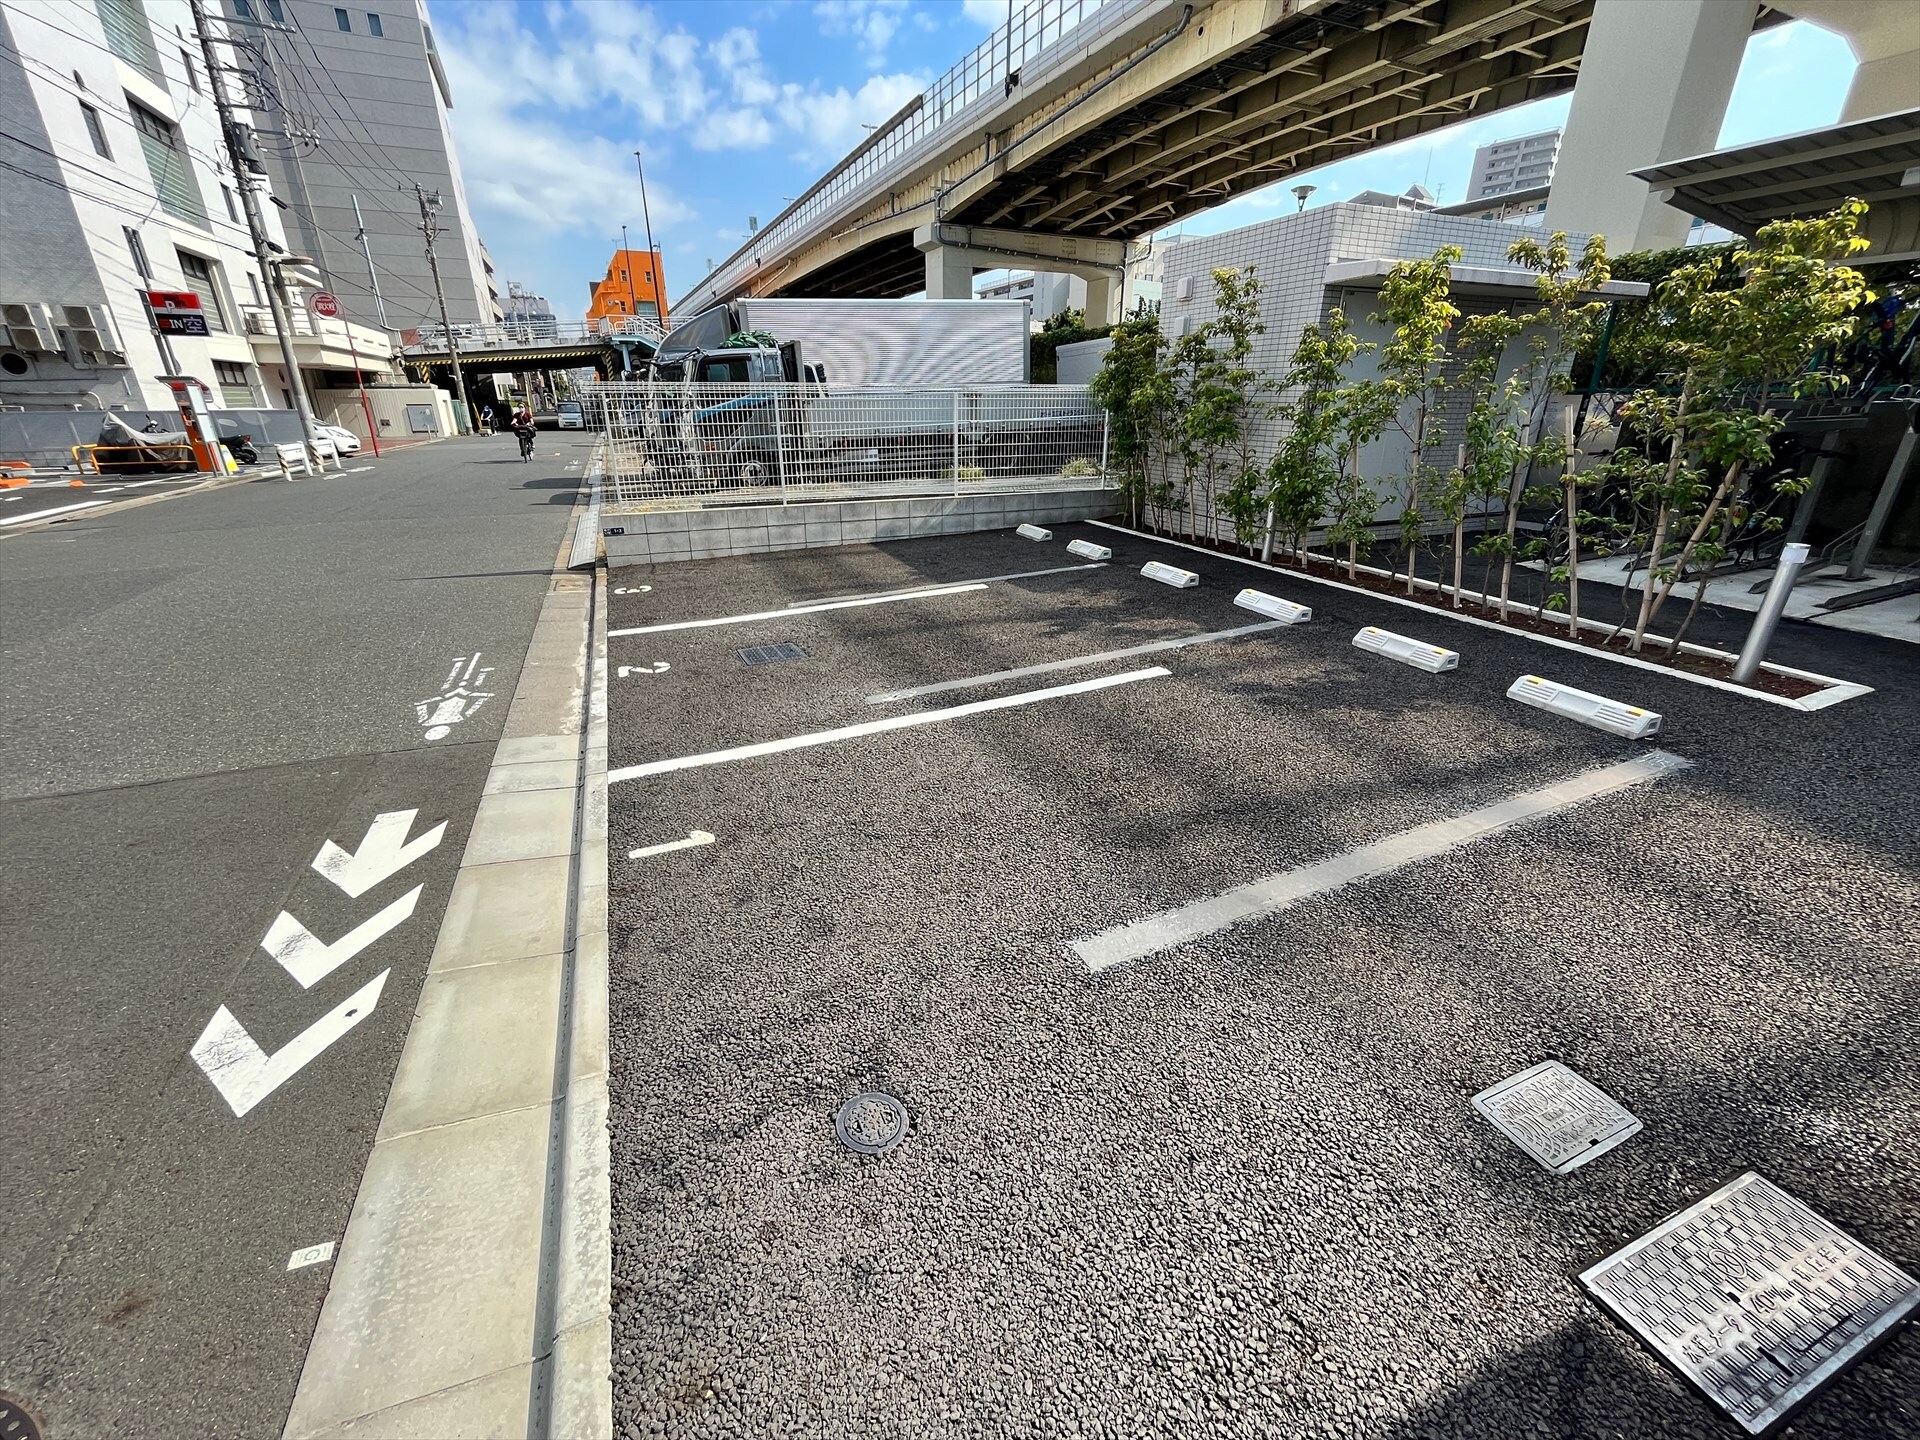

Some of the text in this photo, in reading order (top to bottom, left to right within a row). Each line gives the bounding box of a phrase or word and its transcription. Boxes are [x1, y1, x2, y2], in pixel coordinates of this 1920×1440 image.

[164, 300, 176, 313] P
[169, 319, 184, 329] IN
[183, 316, 206, 334] 空
[614, 585, 652, 595] 3
[618, 661, 671, 678] 2
[629, 830, 716, 859] 1
